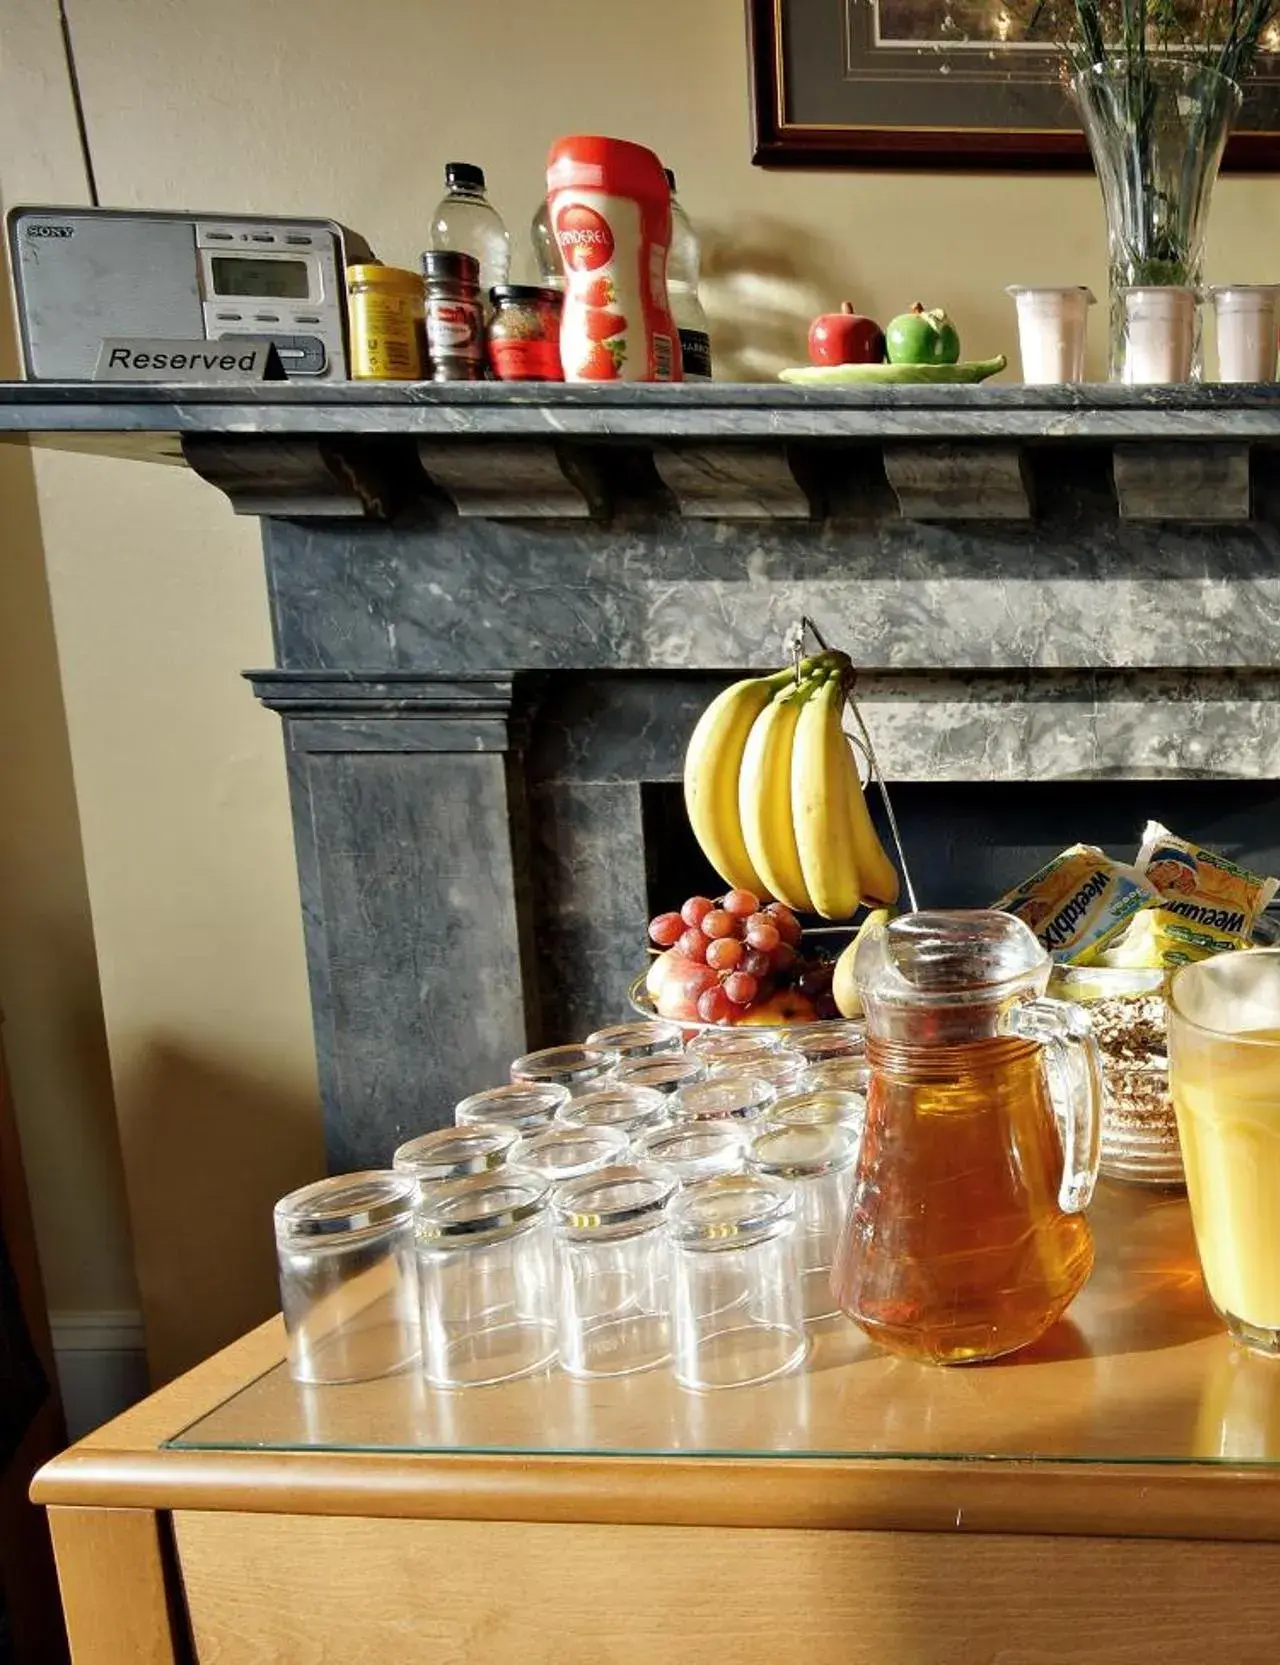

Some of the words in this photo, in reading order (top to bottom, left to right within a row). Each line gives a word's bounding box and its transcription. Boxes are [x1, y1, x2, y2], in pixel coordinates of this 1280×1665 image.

[27, 225, 75, 238] SONY
[108, 348, 257, 372] Reserved
[1040, 870, 1111, 949] Weetabix
